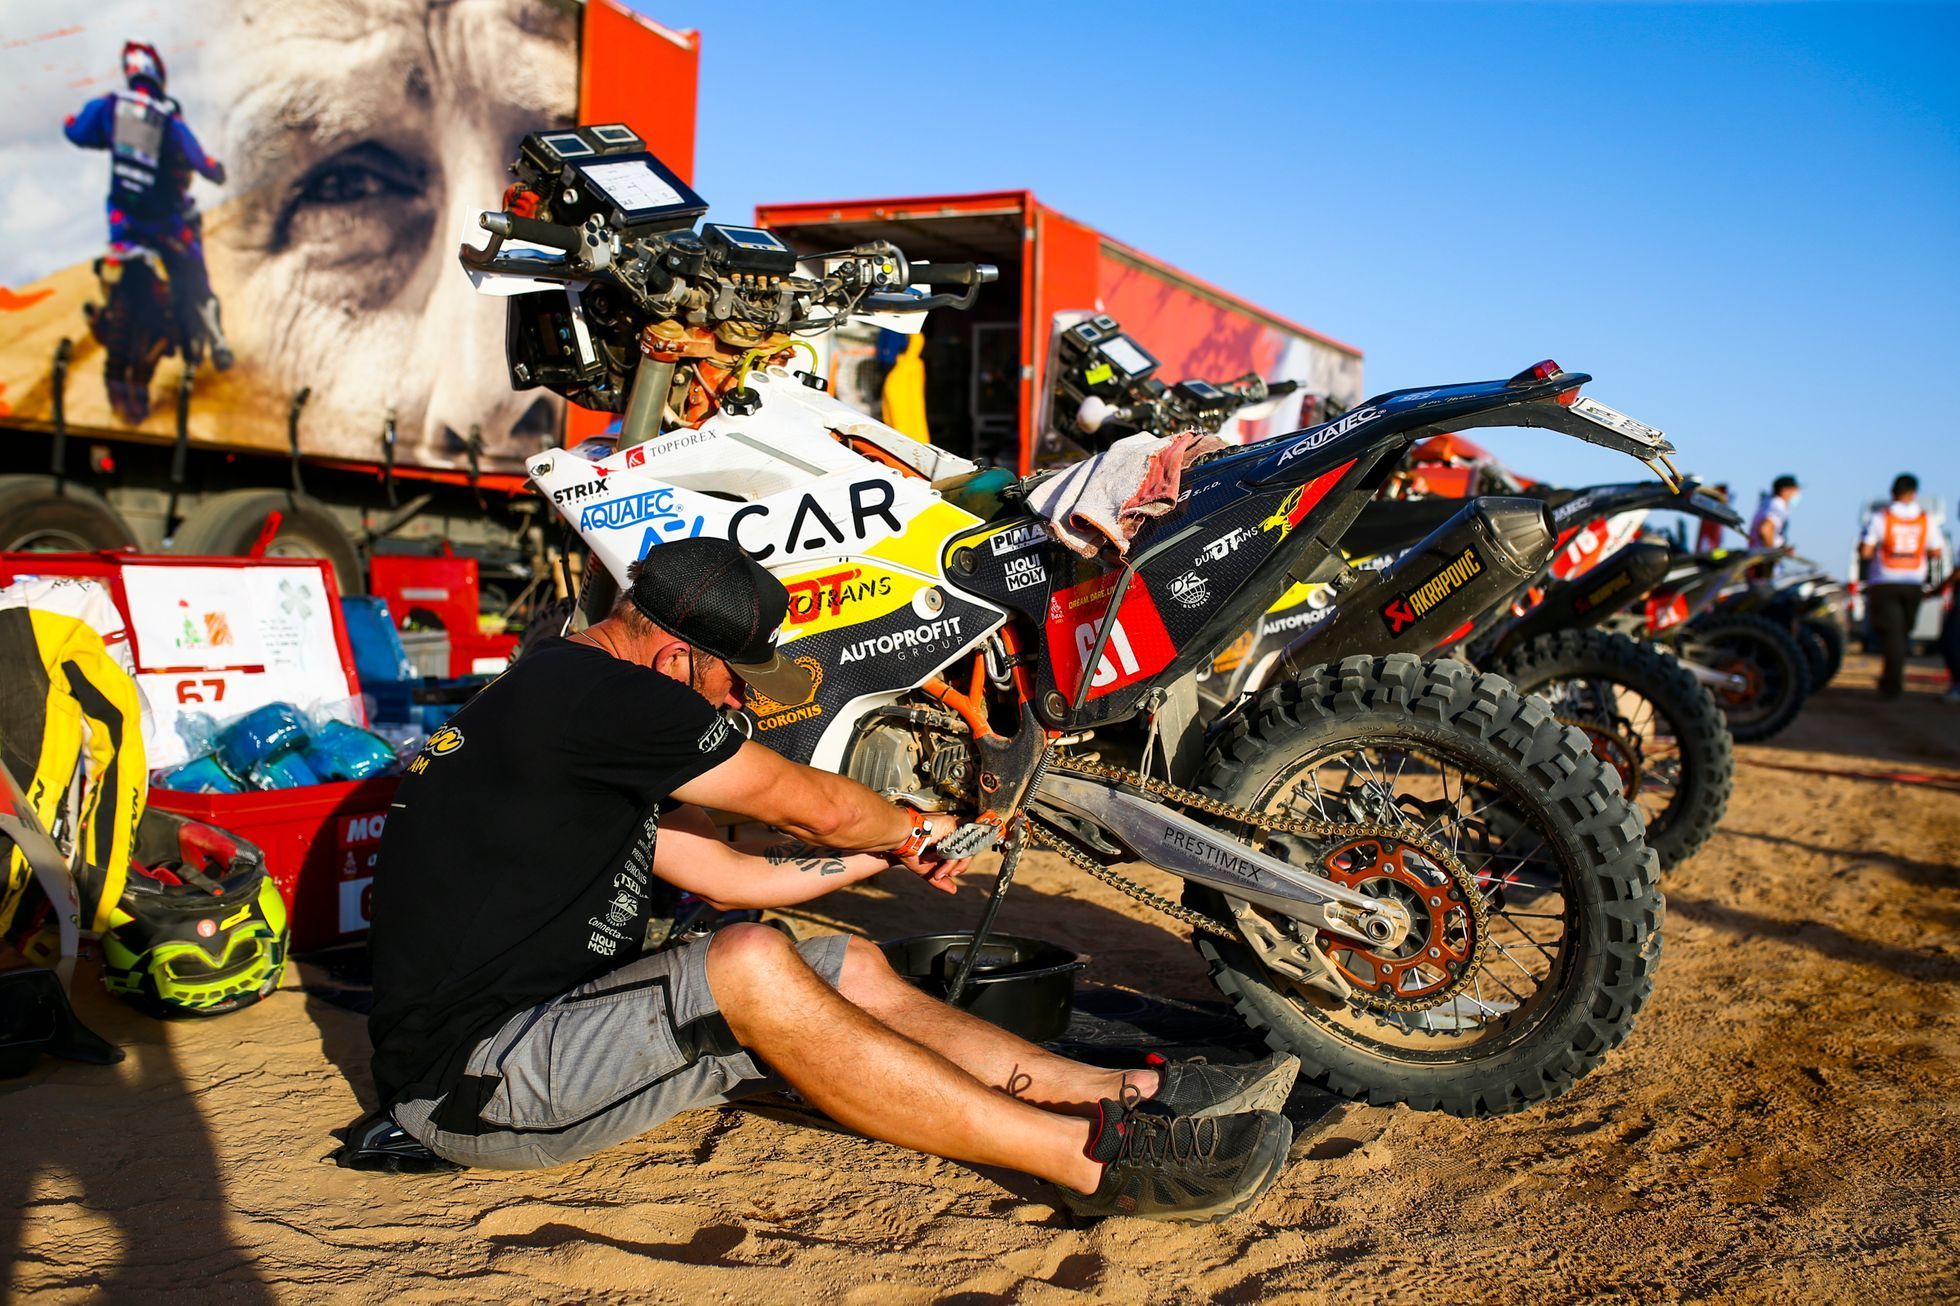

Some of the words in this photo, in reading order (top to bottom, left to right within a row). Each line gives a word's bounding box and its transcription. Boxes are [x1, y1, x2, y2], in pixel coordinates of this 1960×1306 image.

[649, 429, 718, 457] TOPFOREX
[553, 477, 609, 504] STRIX
[993, 523, 1045, 550] PIMA
[1004, 553, 1041, 576] LIQUI
[1008, 567, 1043, 590] MOLY
[1409, 548, 1481, 616] AKRAPOVIČ
[839, 615, 961, 665] AUTOPROFIT
[897, 636, 964, 661] GROUP
[757, 704, 823, 731] CORONIS
[1164, 826, 1262, 882] PRESTIMEX
[624, 859, 648, 885] CORONIS
[588, 916, 622, 939] Connecta
[590, 931, 617, 949] LIQUI
[587, 940, 617, 956] MOLY
